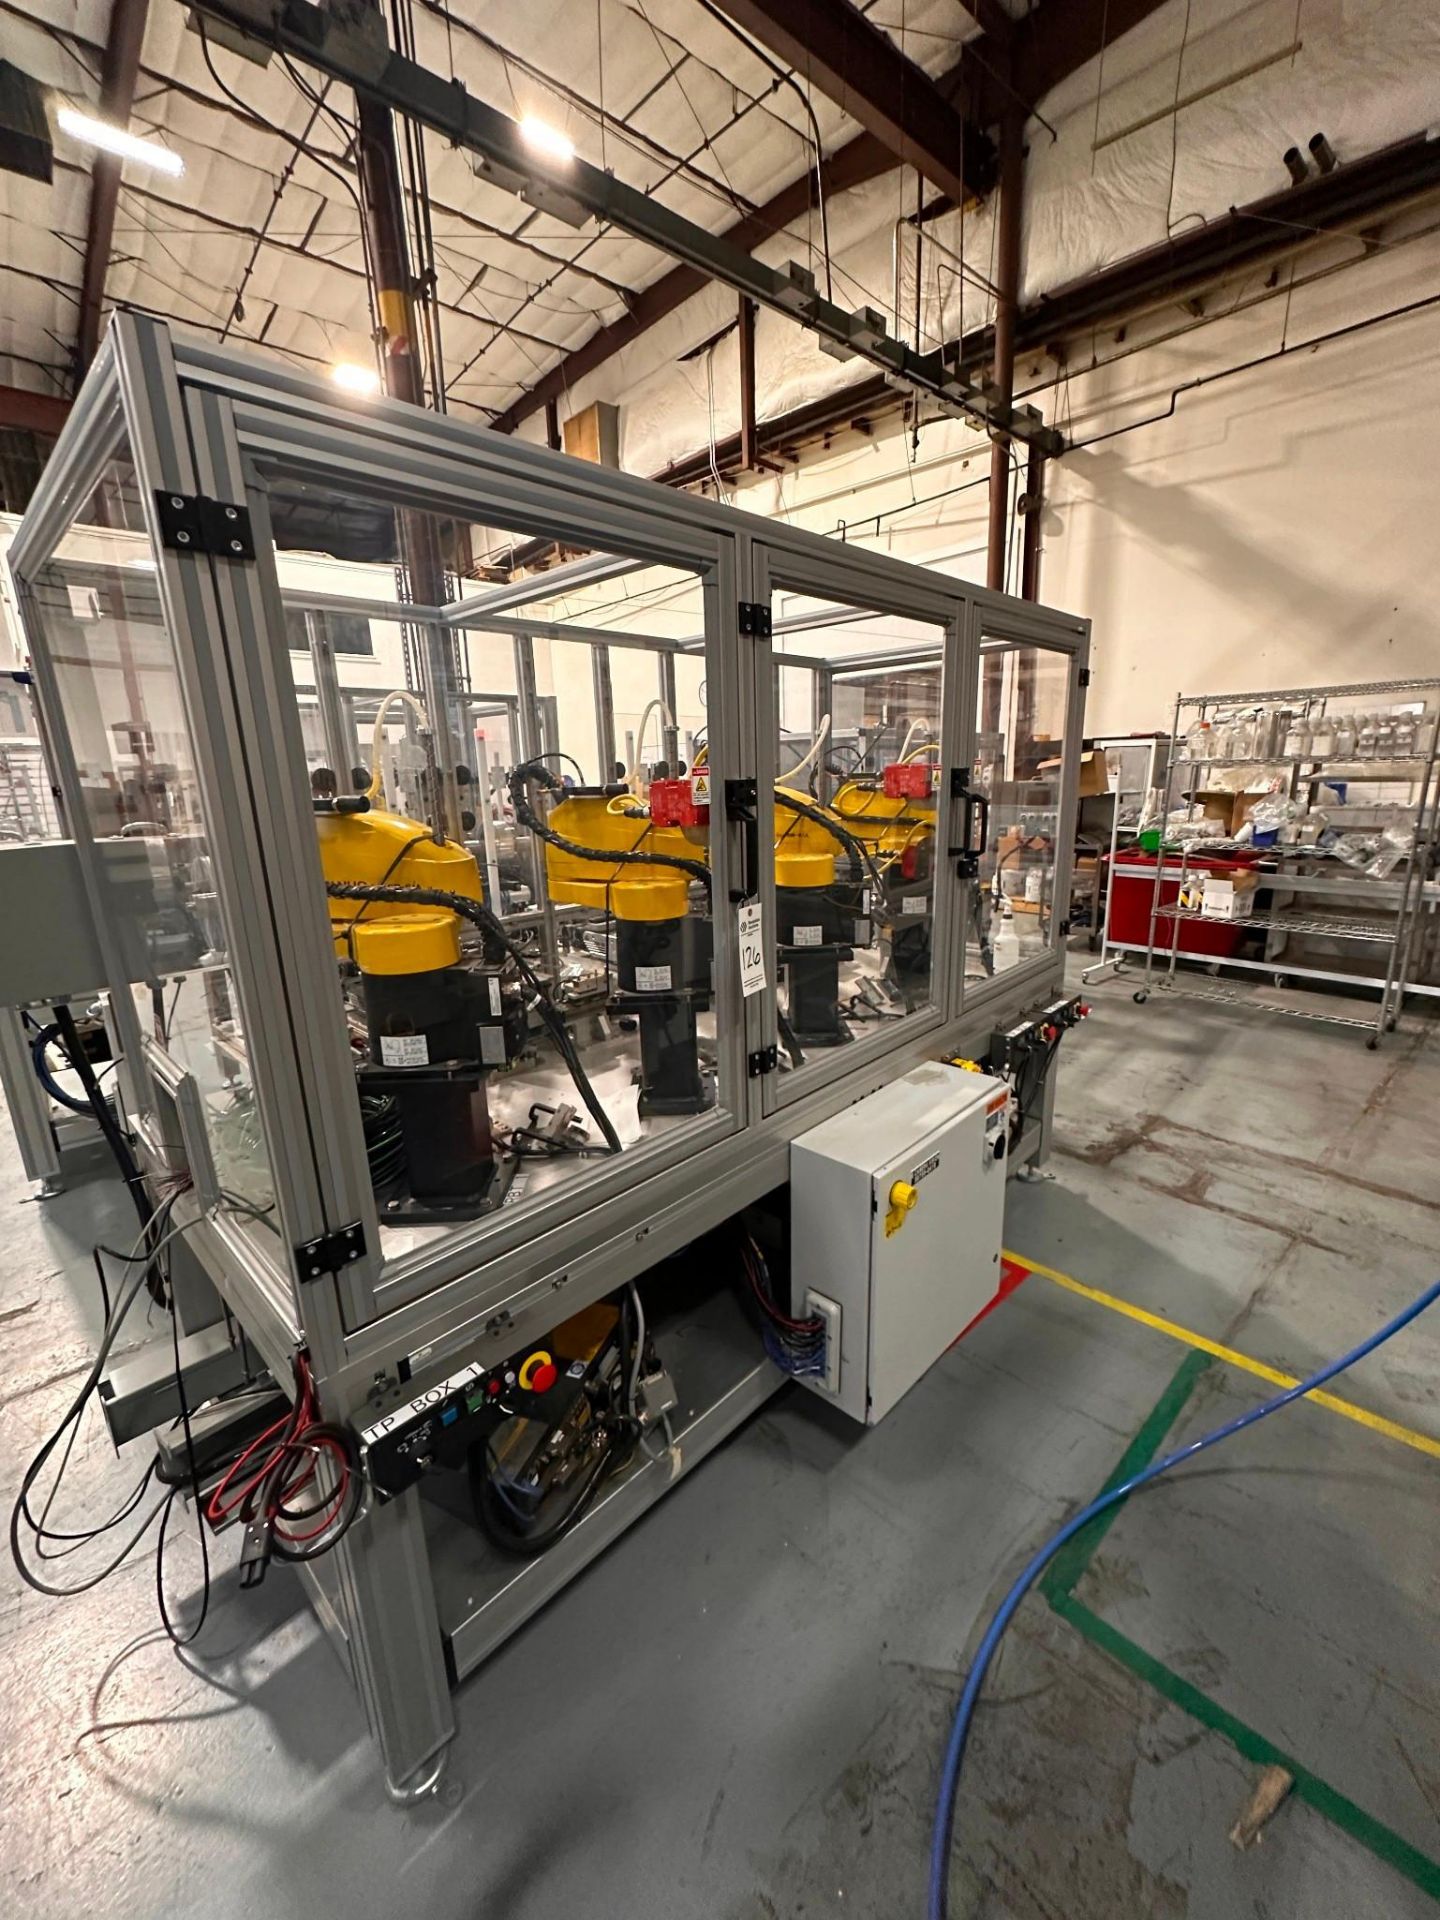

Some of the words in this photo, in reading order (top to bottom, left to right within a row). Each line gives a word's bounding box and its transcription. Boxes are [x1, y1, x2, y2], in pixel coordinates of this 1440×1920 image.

[742, 945, 761, 971] 126
[364, 1416, 395, 1439] TP
[410, 1380, 457, 1413] BOX
[466, 1366, 478, 1376] 1
